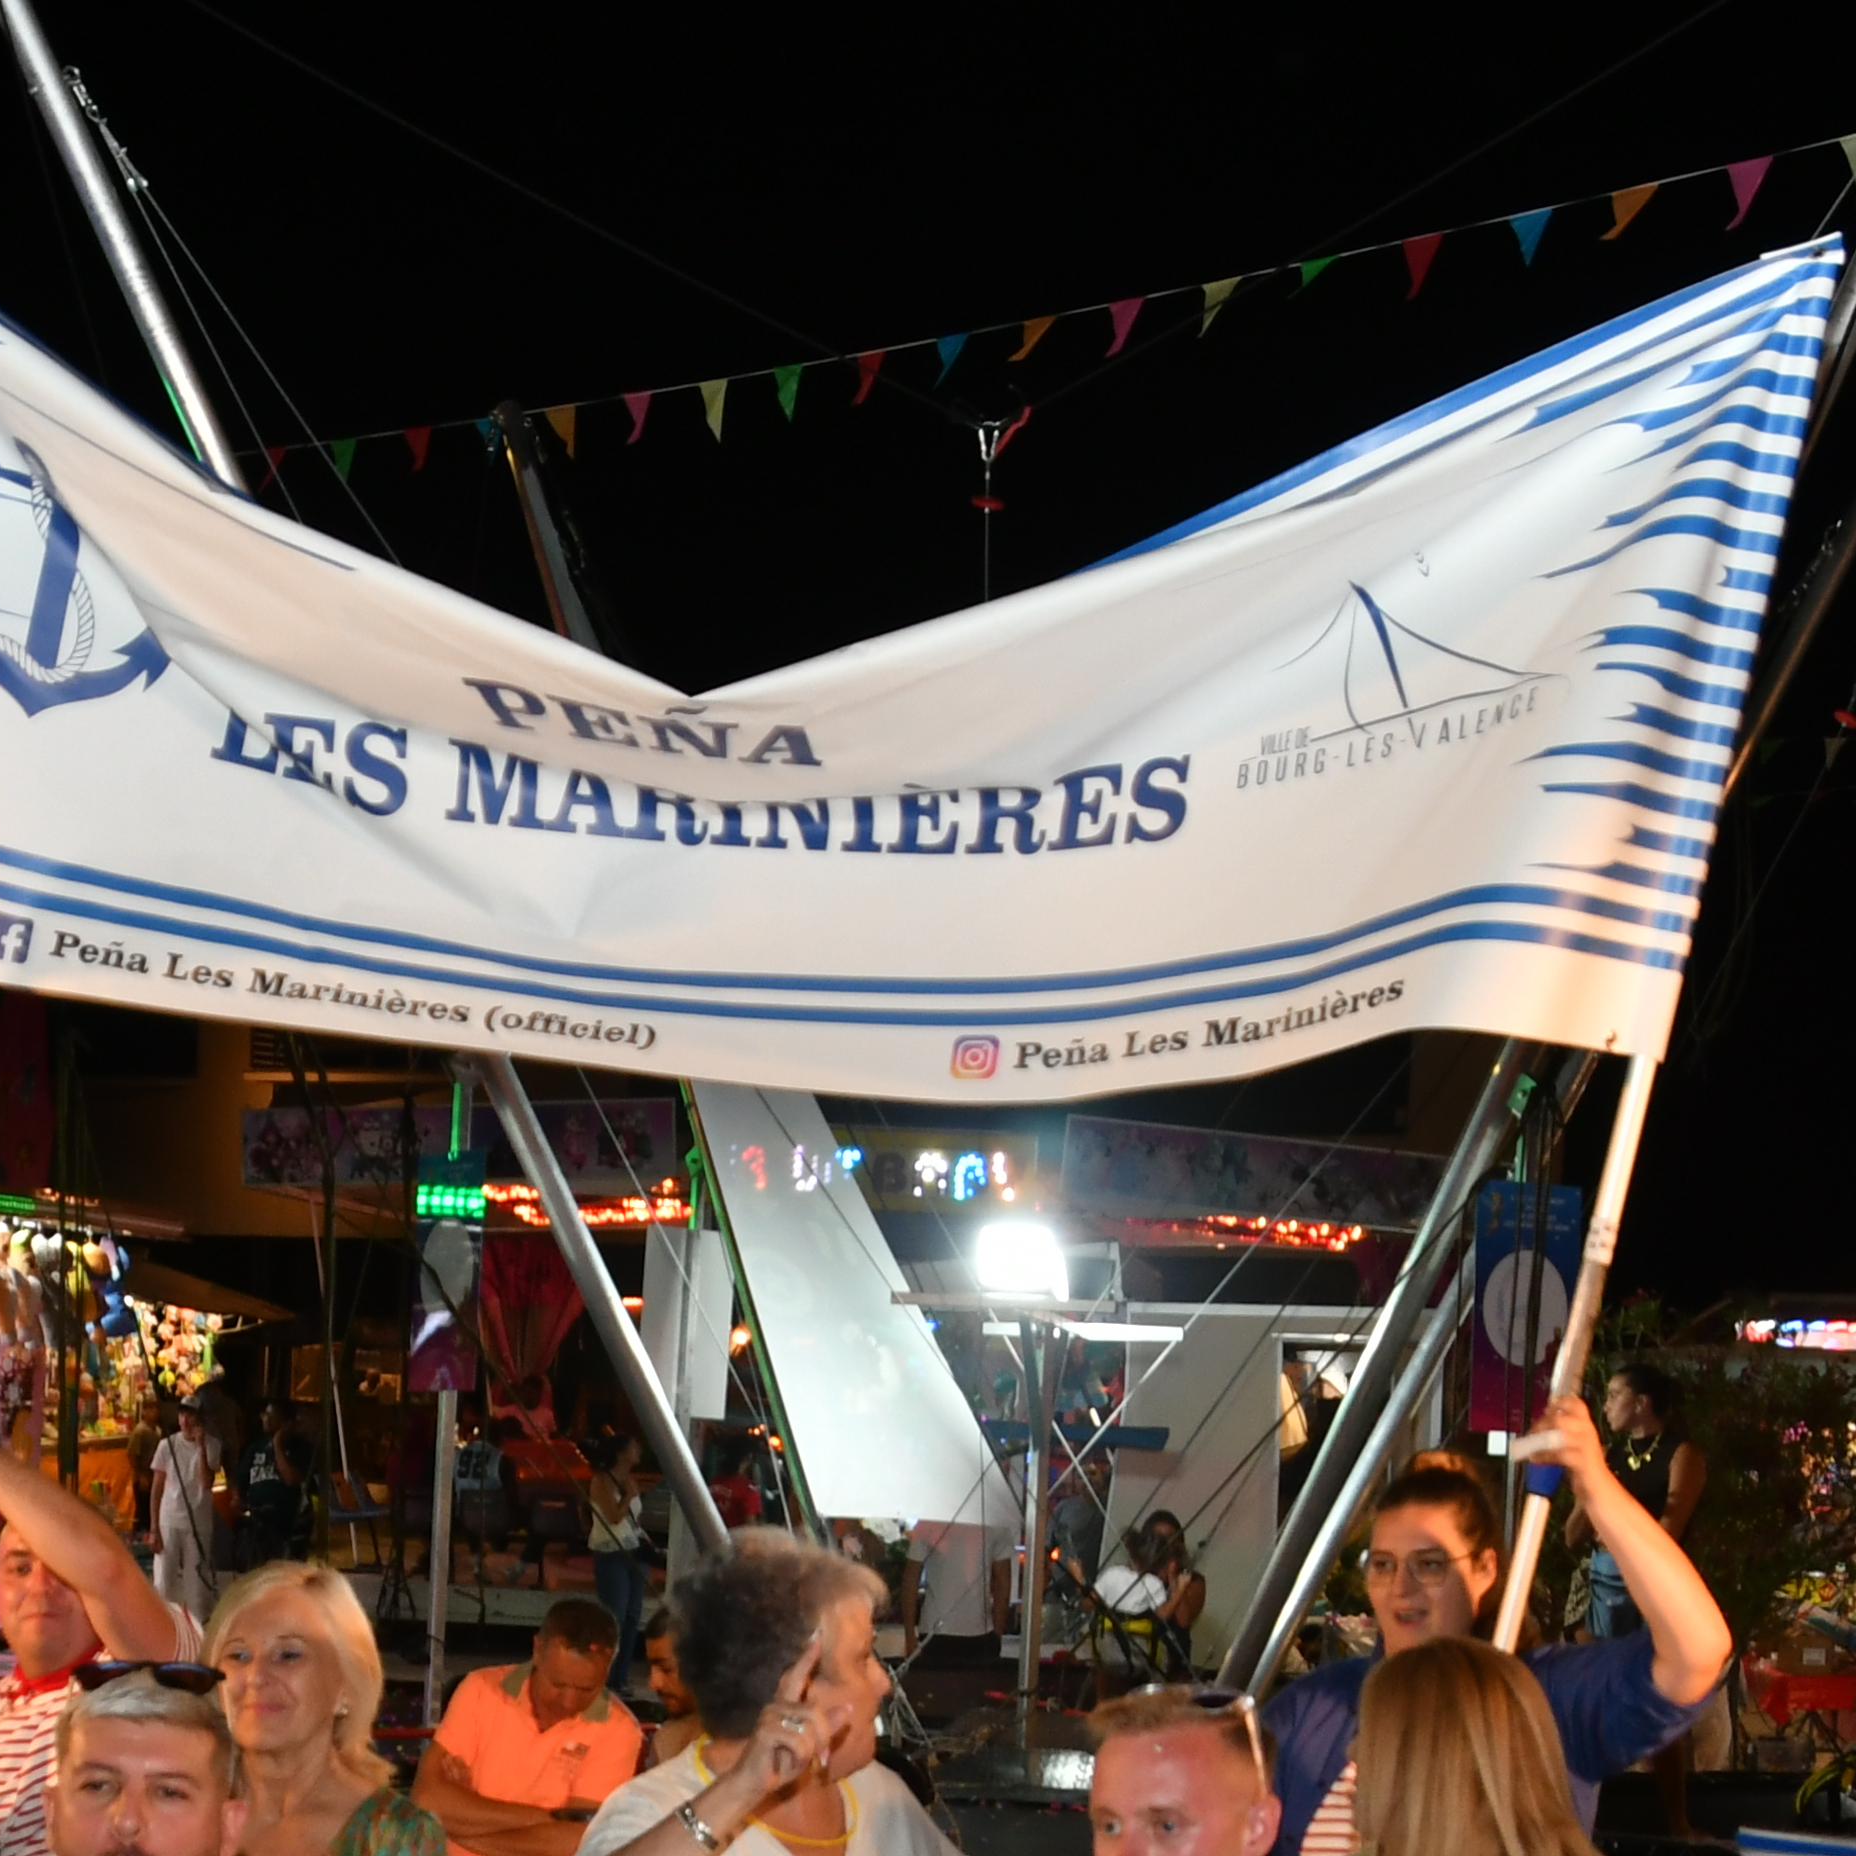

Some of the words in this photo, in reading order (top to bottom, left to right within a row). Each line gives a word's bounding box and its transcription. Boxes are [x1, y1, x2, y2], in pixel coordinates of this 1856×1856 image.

[209, 704, 409, 818] LES
[462, 674, 825, 767] PEÑA
[47, 930, 153, 981] Peña
[162, 951, 236, 990] Les
[247, 967, 472, 1025] Marinières
[483, 1001, 661, 1052] (officiel)
[1012, 1029, 1111, 1074] Peña
[1122, 1020, 1190, 1058] Les
[1201, 974, 1408, 1048] Marinières
